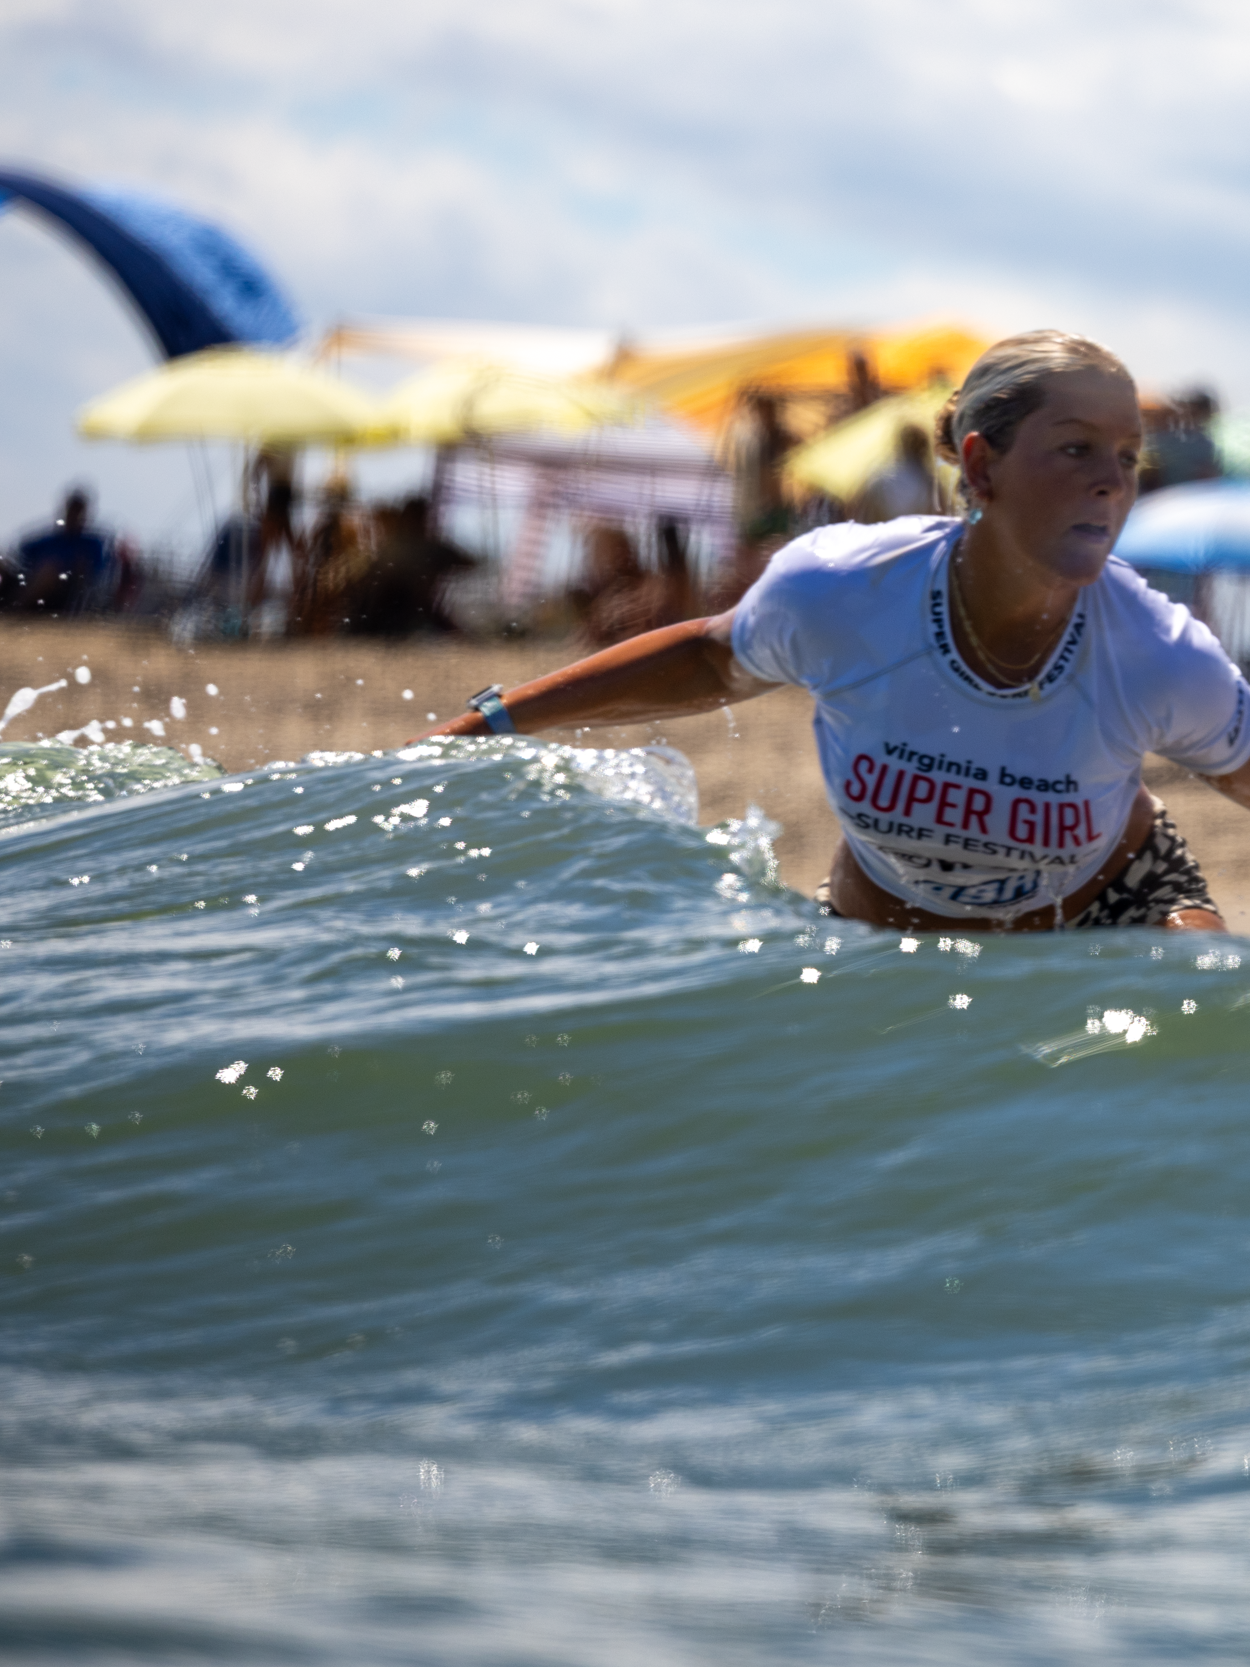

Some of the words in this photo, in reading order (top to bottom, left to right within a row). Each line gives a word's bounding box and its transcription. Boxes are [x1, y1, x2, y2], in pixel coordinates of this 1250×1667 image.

[931, 590, 952, 656] SUPER
[883, 741, 990, 782] virginia
[998, 766, 1079, 793] beach
[844, 753, 993, 835] SUPER
[1007, 797, 1103, 849] GIRL
[852, 811, 934, 841] SURF
[943, 831, 1081, 866] FESTIVAL
